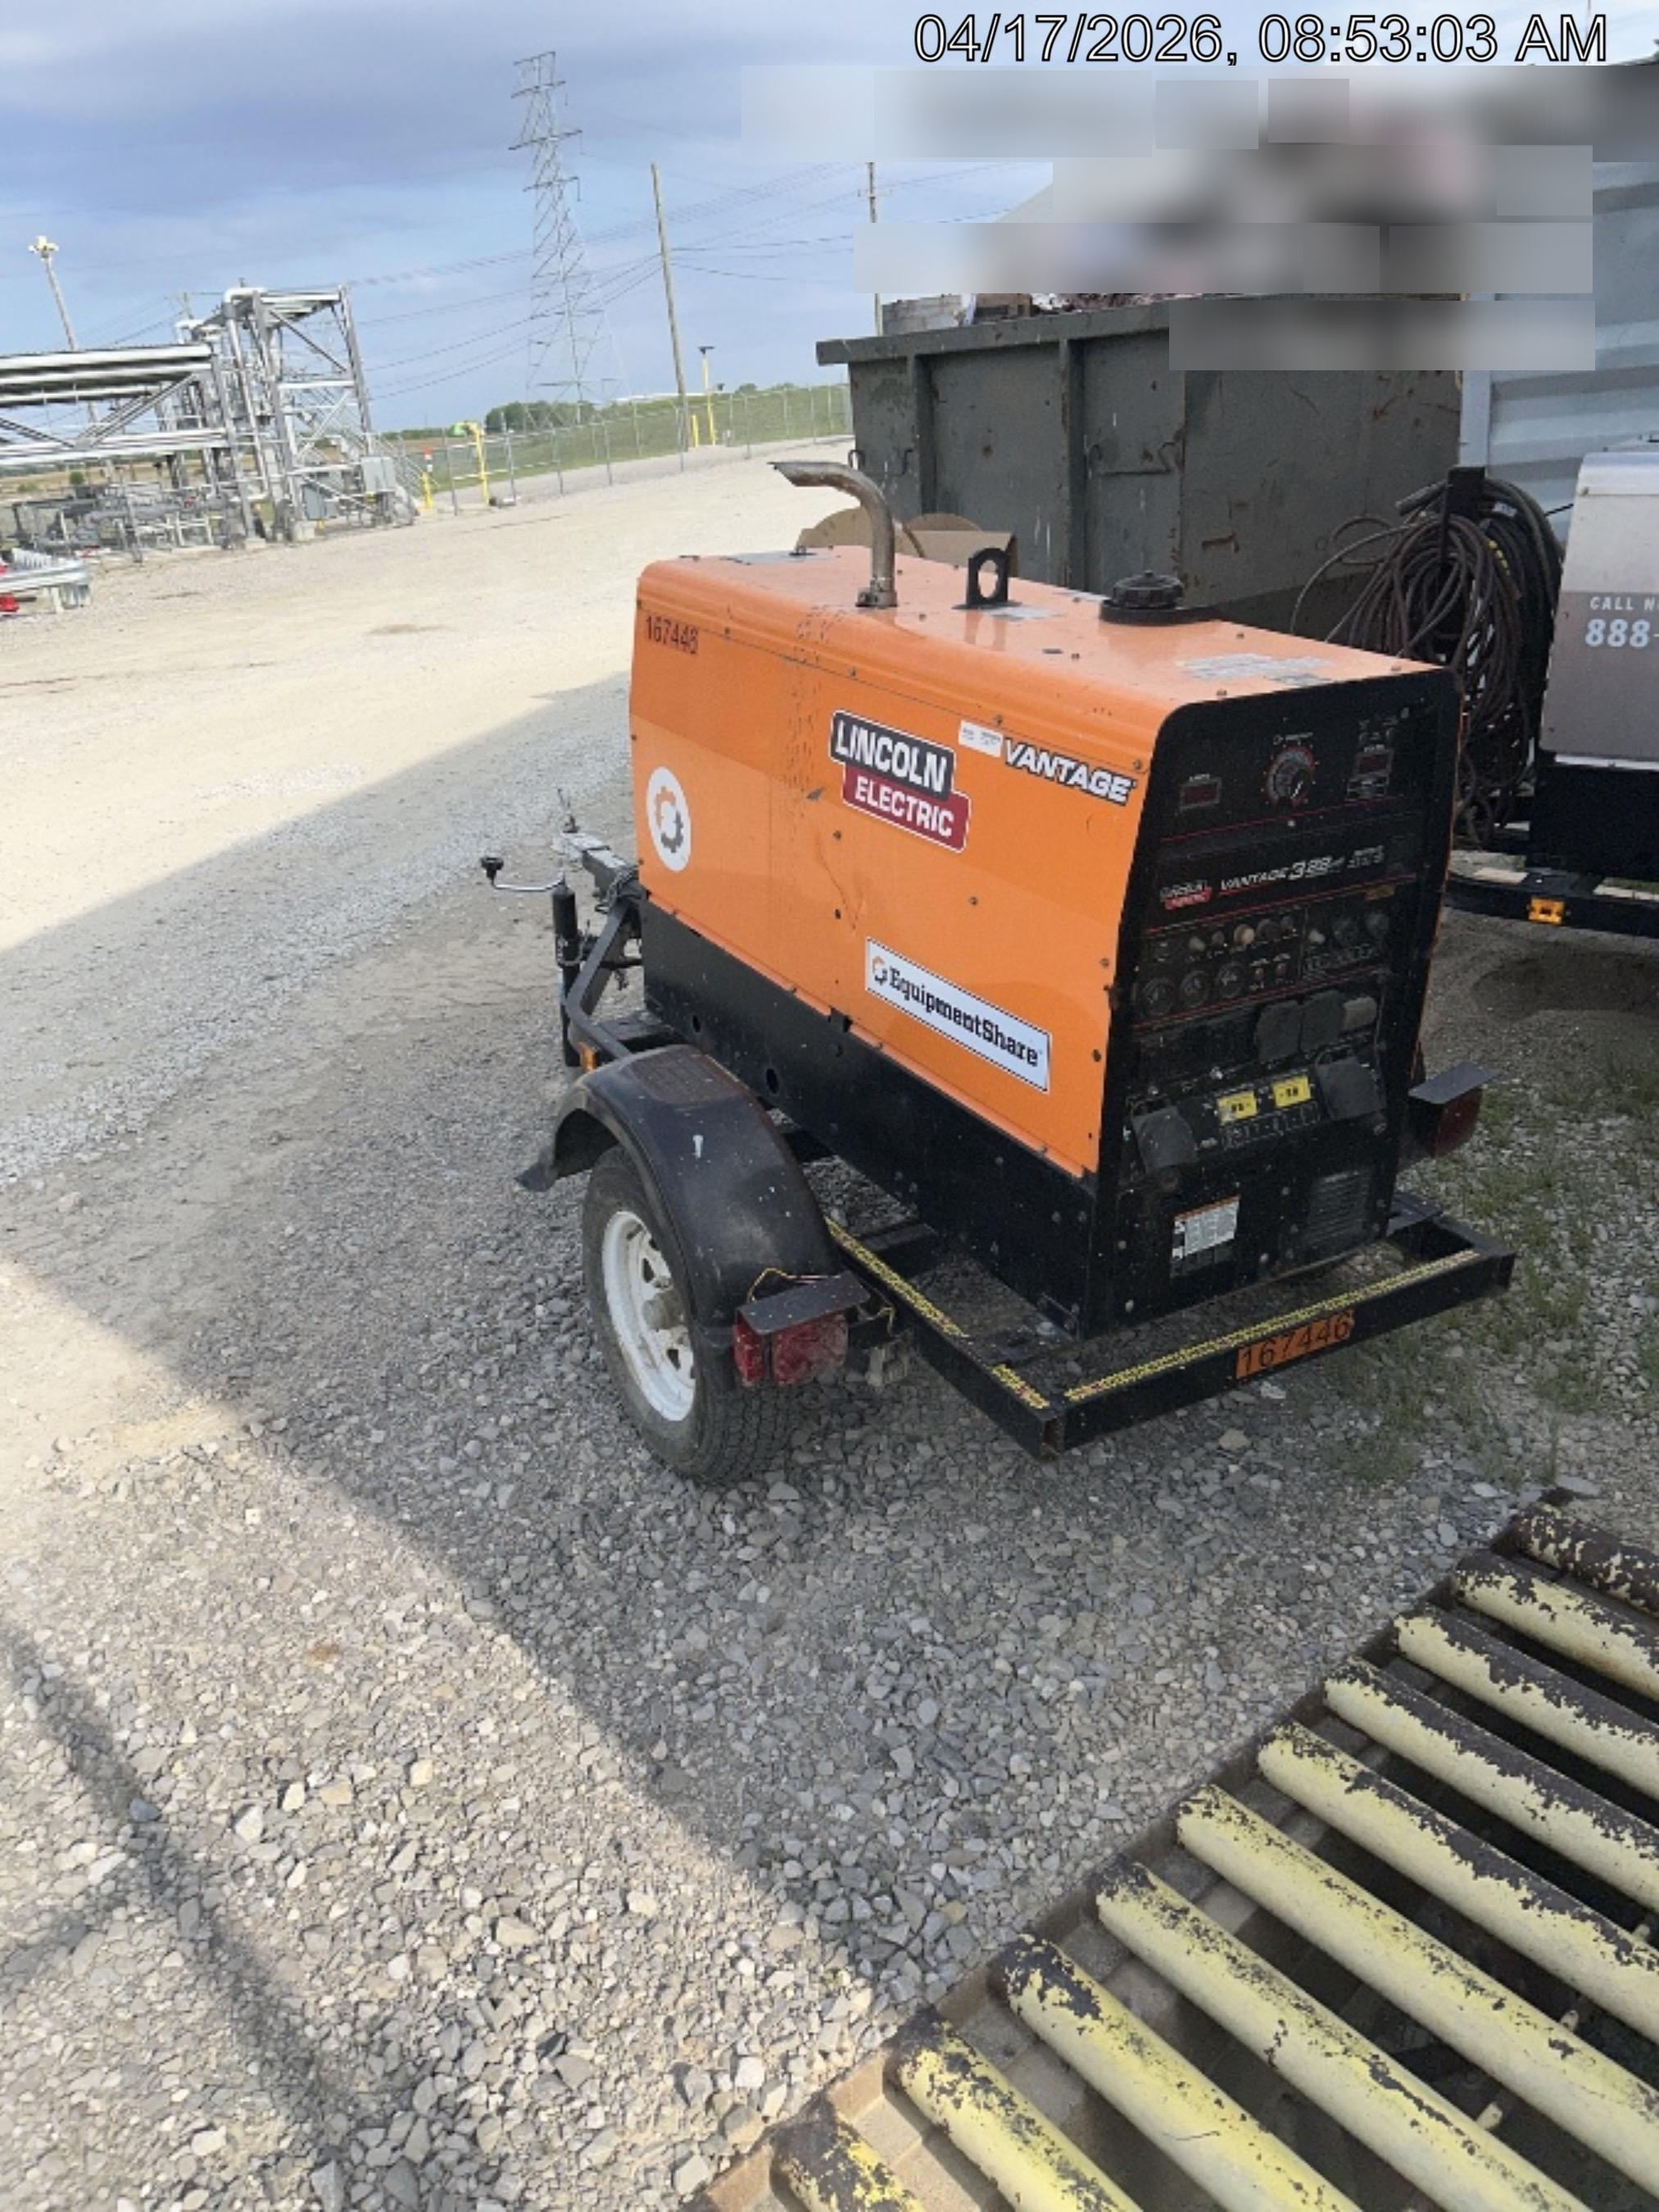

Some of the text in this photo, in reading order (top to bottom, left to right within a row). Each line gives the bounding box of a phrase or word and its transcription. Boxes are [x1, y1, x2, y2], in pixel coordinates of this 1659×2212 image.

[1590, 596, 1659, 612] CALL N
[835, 719, 948, 794] LINCOLN
[1004, 737, 1133, 806] VANTAGE
[854, 774, 955, 838] ELECTRIC
[889, 965, 1039, 1067] EquipmentShare
[1240, 1311, 1353, 1373] 167446
